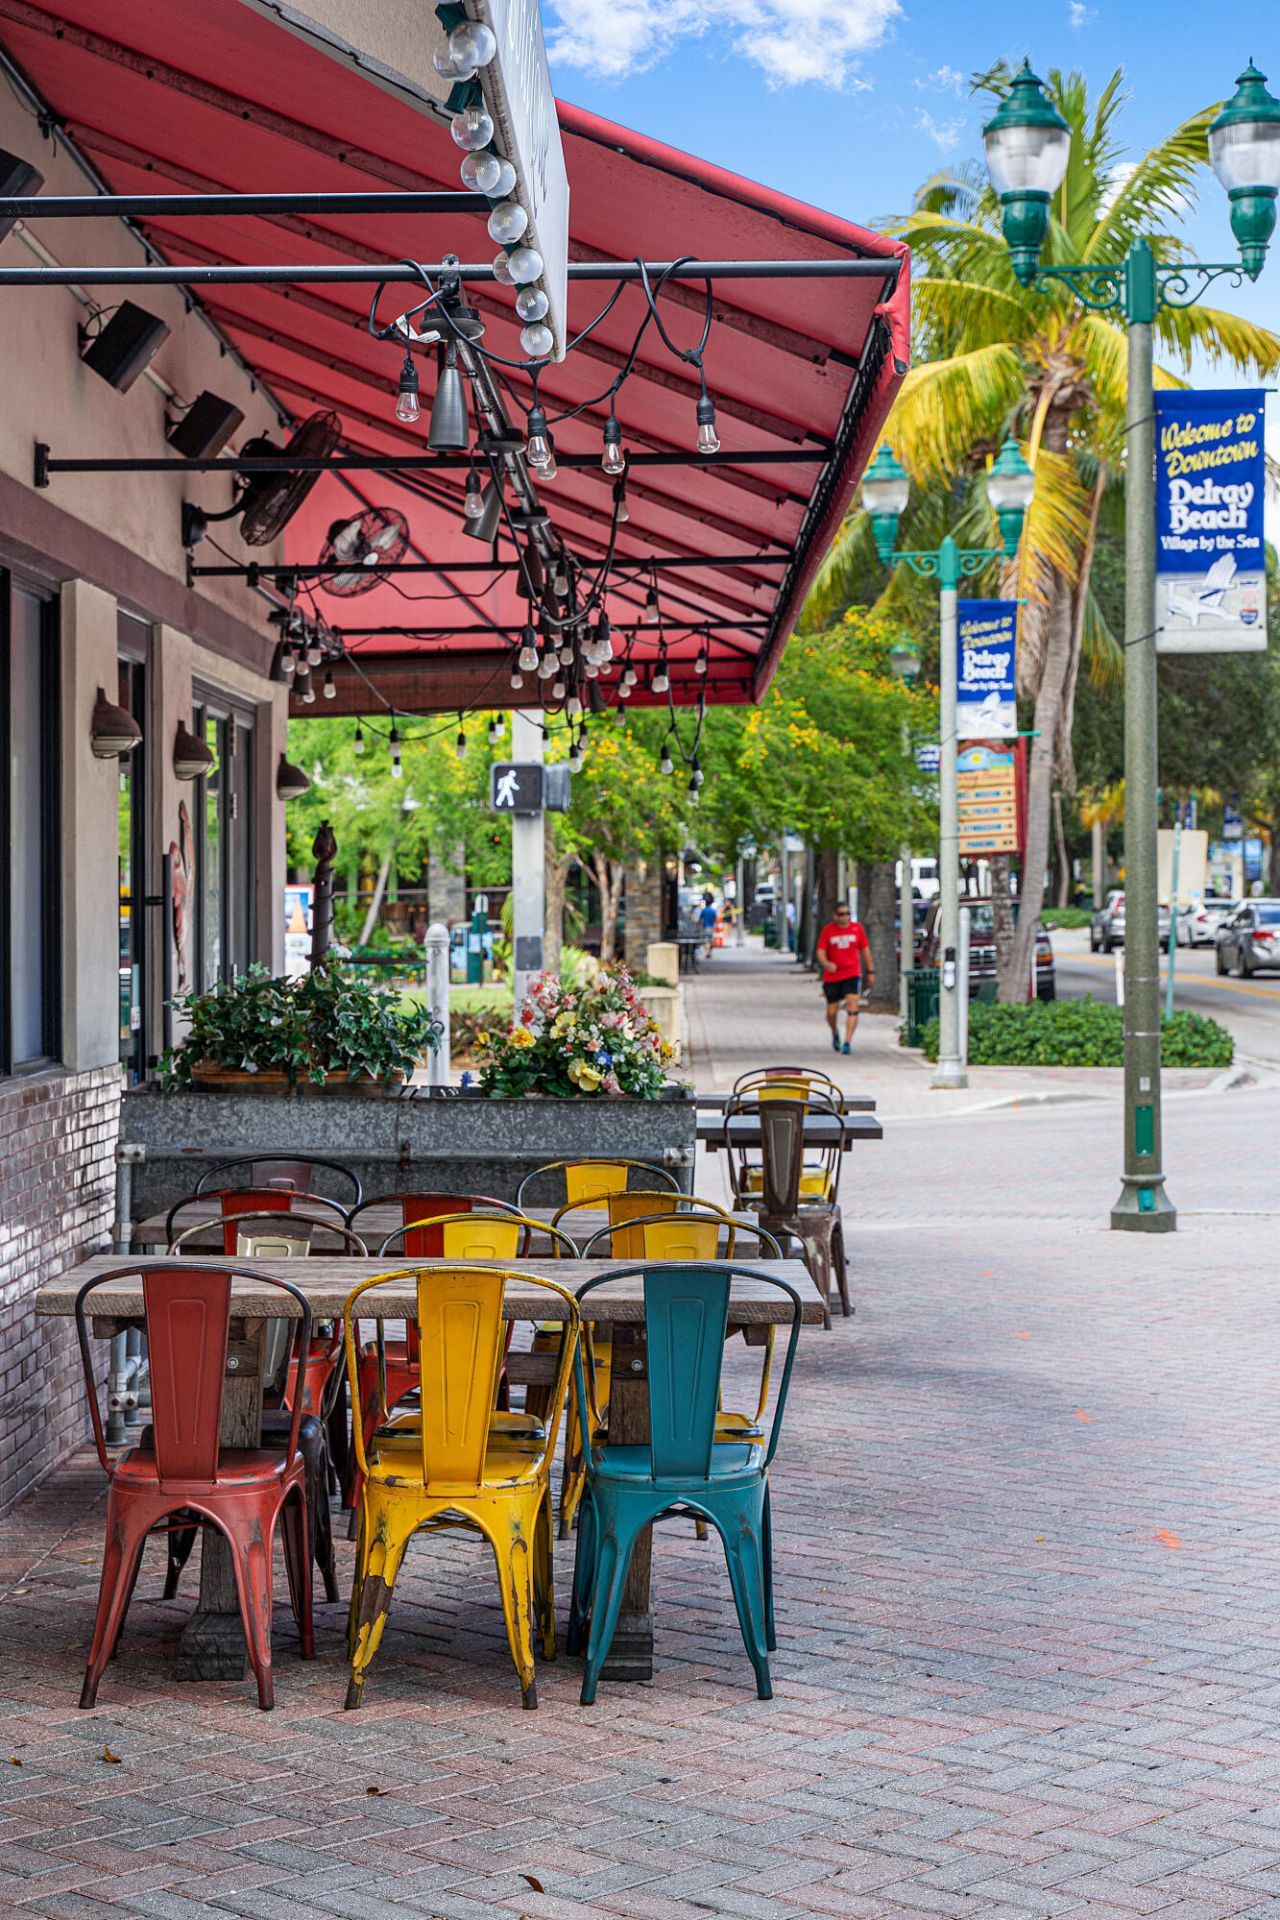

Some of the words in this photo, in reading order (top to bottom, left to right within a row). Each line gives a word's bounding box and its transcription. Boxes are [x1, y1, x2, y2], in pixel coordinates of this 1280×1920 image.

[1161, 421, 1233, 451] Welcome
[1236, 413, 1256, 434] to
[1164, 440, 1259, 478] Downtown
[1168, 478, 1254, 509] Delray
[1168, 503, 1247, 534] Beach
[1160, 535, 1198, 552] Village
[1199, 535, 1215, 552] by
[1216, 534, 1236, 549] the
[1236, 533, 1259, 549] Sea
